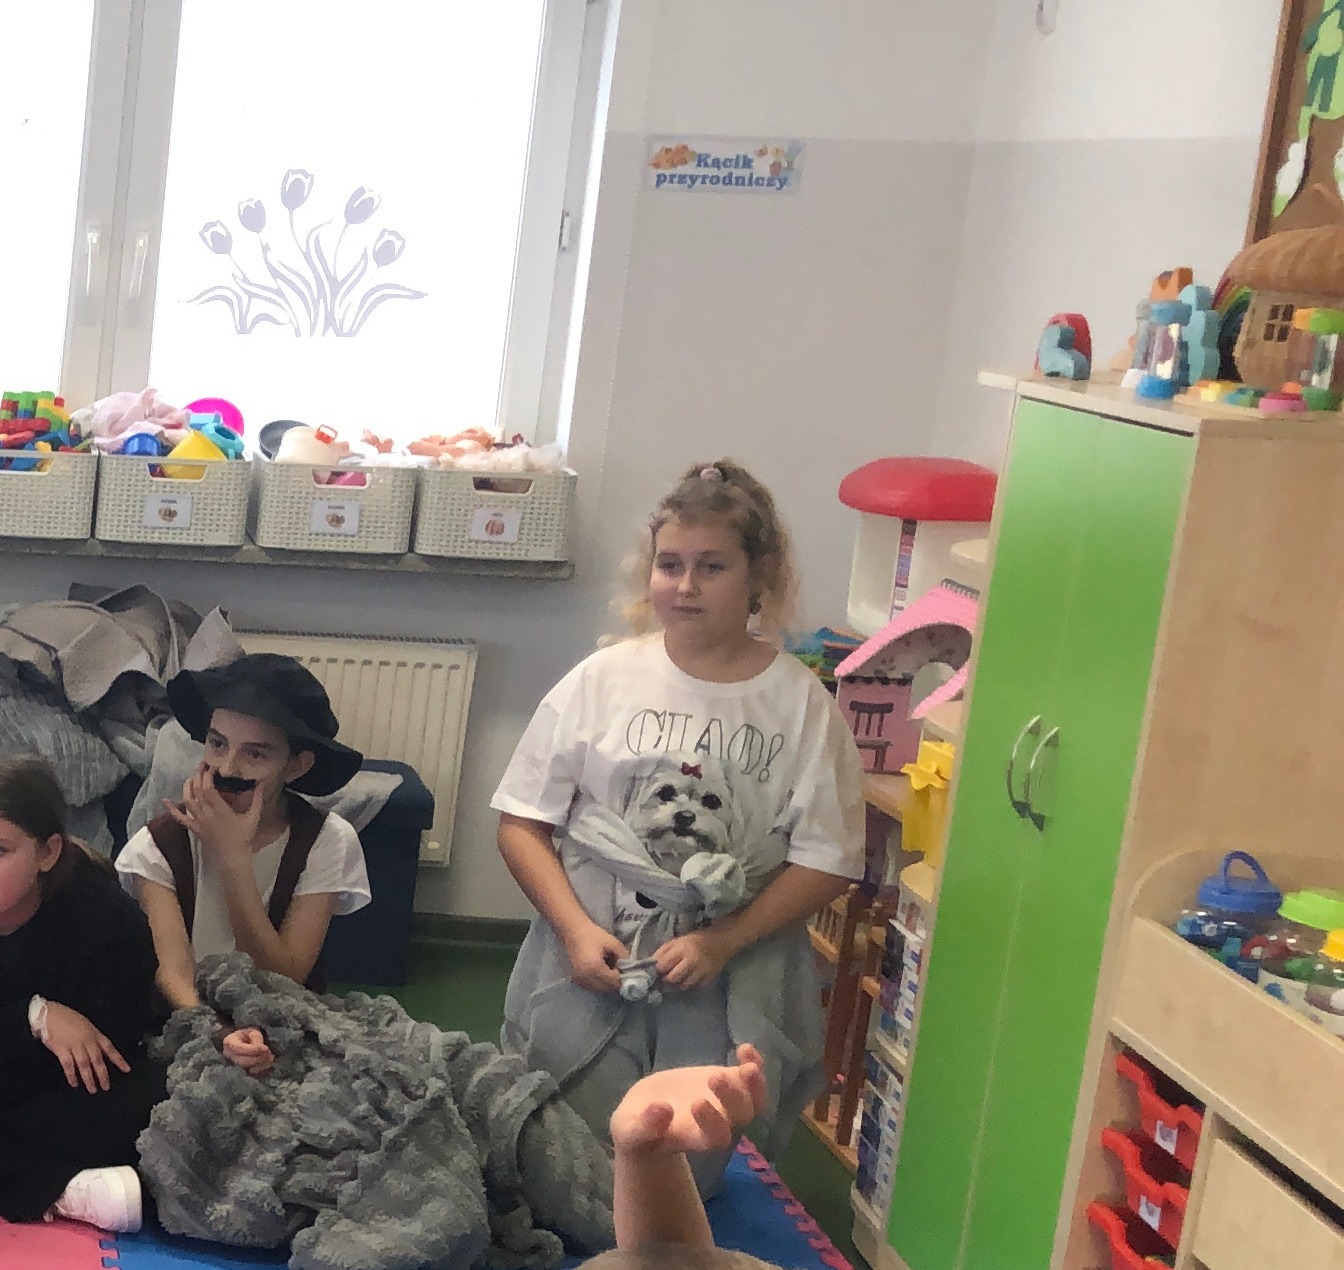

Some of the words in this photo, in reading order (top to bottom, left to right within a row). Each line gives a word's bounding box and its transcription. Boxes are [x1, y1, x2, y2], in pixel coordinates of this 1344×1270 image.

[695, 152, 754, 171] Kącik
[655, 172, 789, 190] przyrodniczy
[626, 708, 785, 783] CIAO!
